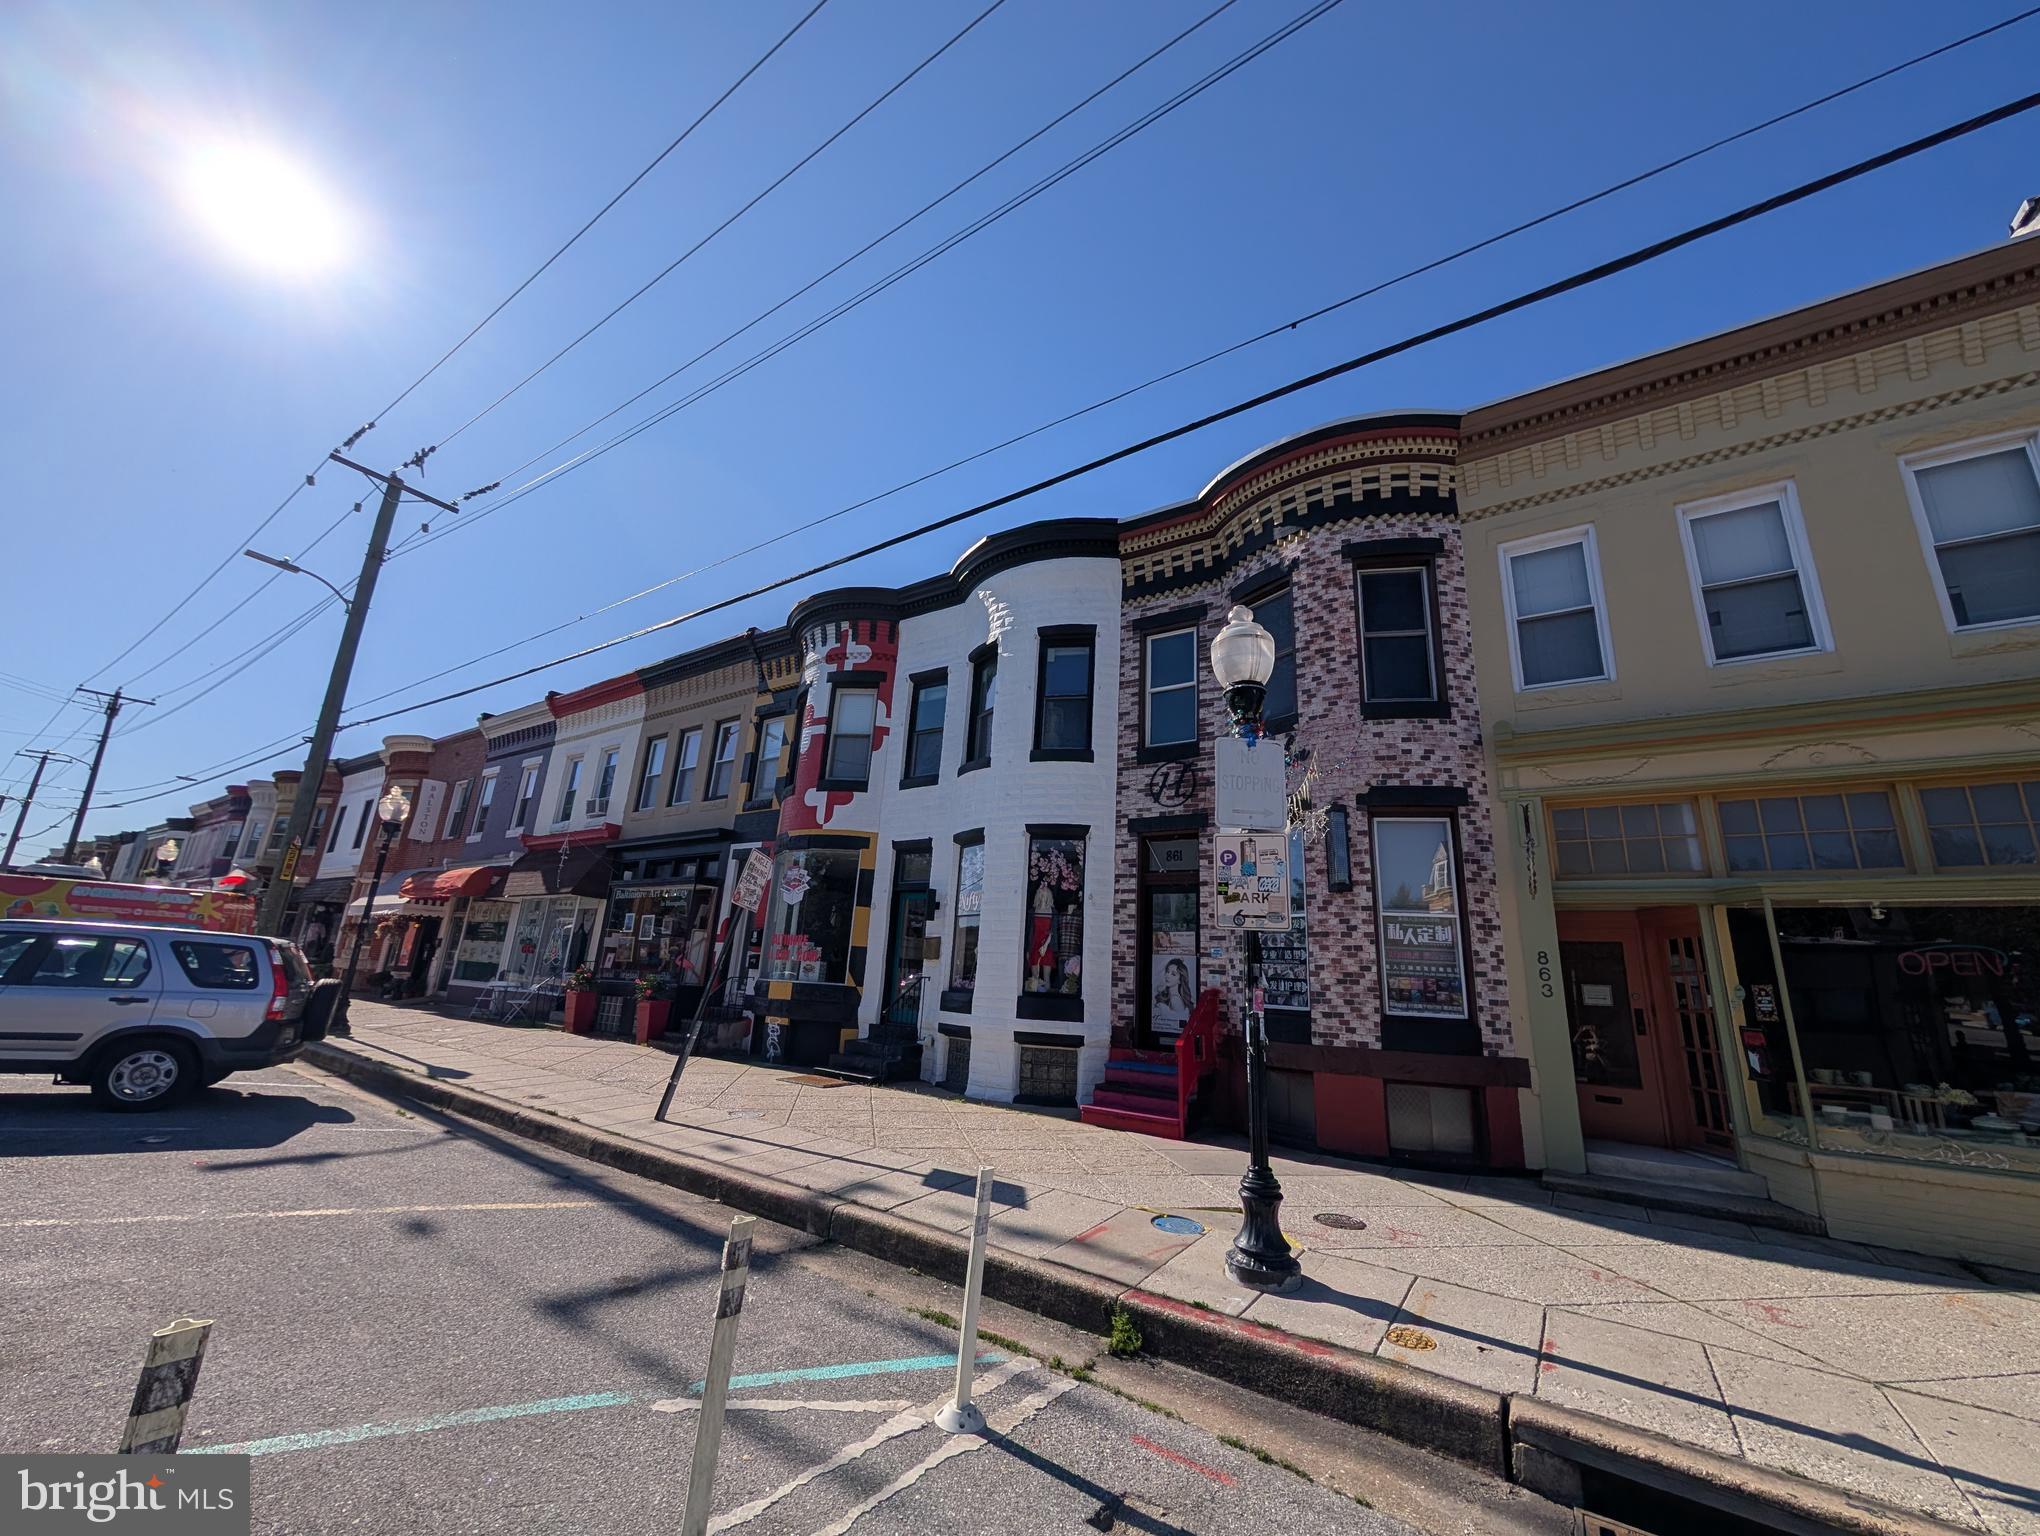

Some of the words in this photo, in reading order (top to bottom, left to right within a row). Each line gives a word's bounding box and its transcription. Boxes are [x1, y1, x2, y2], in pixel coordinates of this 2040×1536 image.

[1240, 749, 1260, 766] NO
[1222, 774, 1281, 793] STOPPING
[1166, 850, 1183, 863] 861
[649, 888, 661, 898] Art
[1240, 892, 1270, 904] ARK
[1387, 923, 1453, 946] 私人定制
[1896, 951, 2005, 977] OPEN
[1537, 950, 1554, 998] 863
